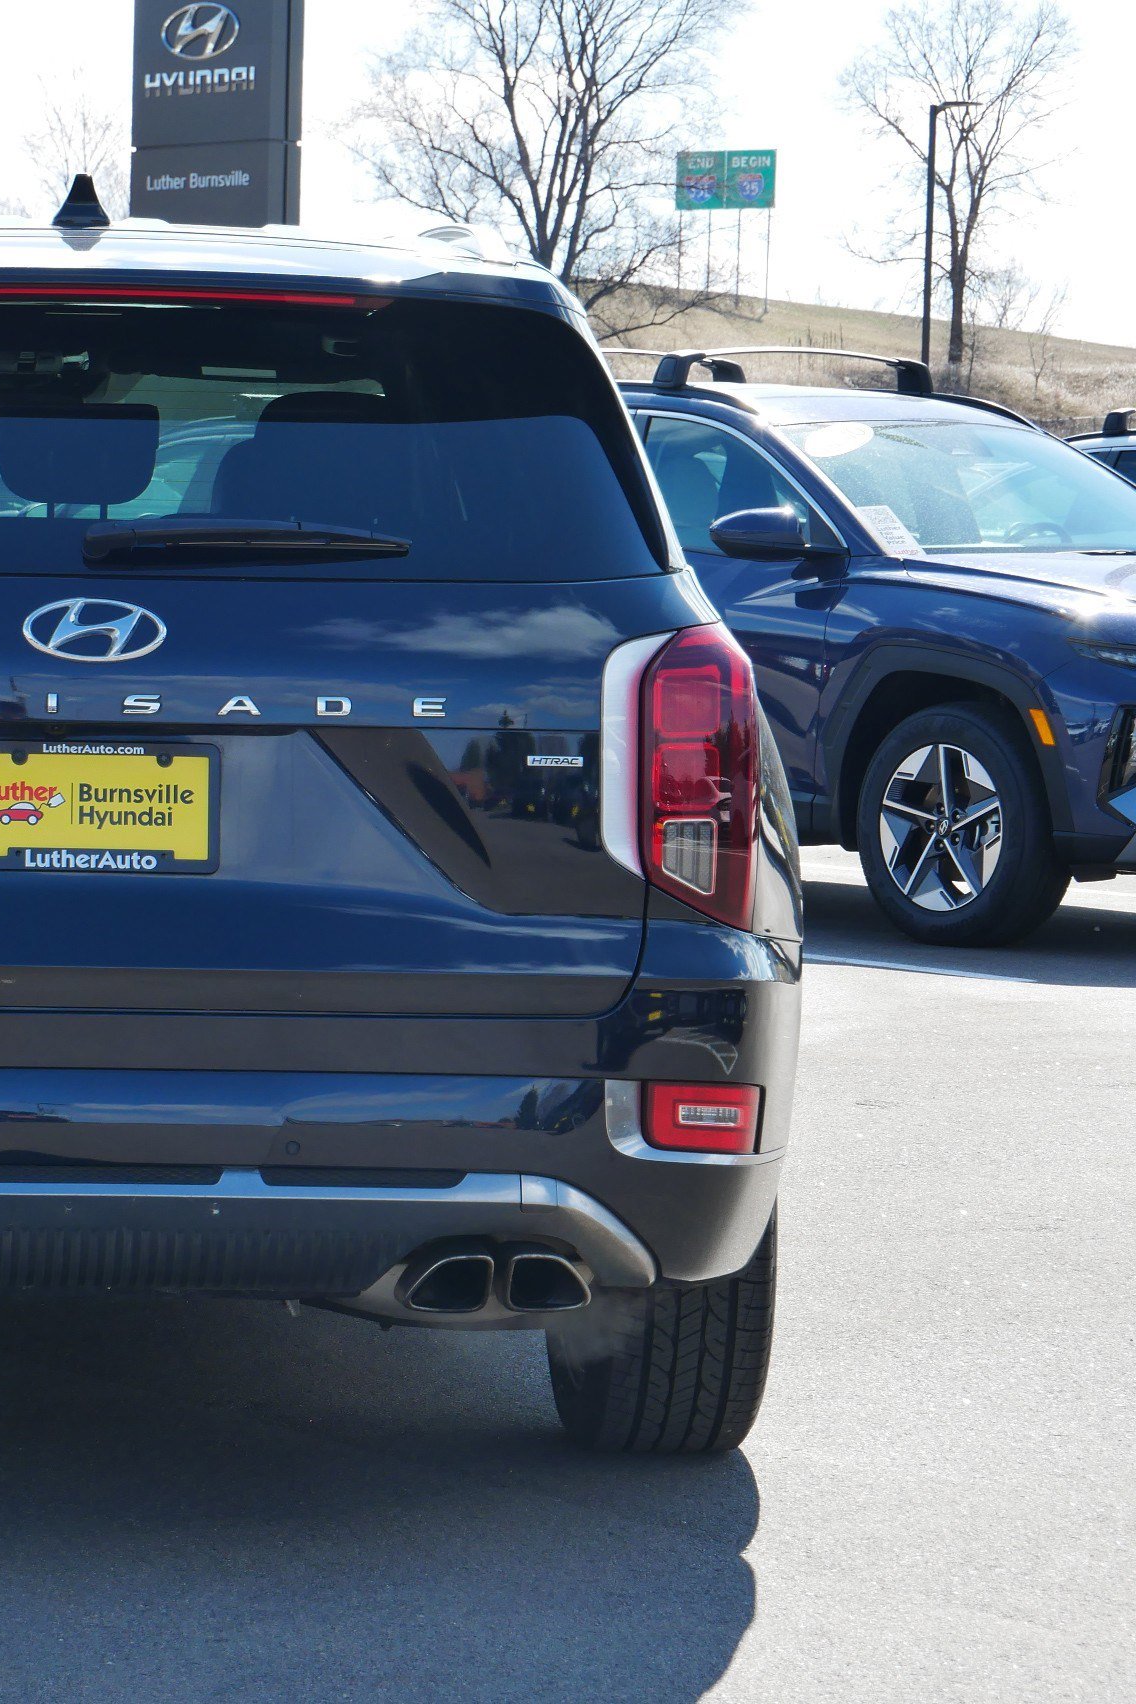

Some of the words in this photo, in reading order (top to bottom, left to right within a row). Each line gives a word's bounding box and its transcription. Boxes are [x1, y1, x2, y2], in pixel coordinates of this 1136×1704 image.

[144, 66, 255, 98] HYUNDAI
[688, 157, 714, 169] END
[731, 155, 771, 168] BEGIN
[146, 174, 186, 191] Luther
[189, 170, 250, 189] Burnsville
[742, 181, 759, 195] 35
[42, 743, 145, 755] LutherAuto.com
[531, 757, 580, 765] HTRAC
[78, 783, 195, 805] Burnsville
[78, 805, 173, 829] Hyundai
[24, 849, 157, 870] LutherAuto
